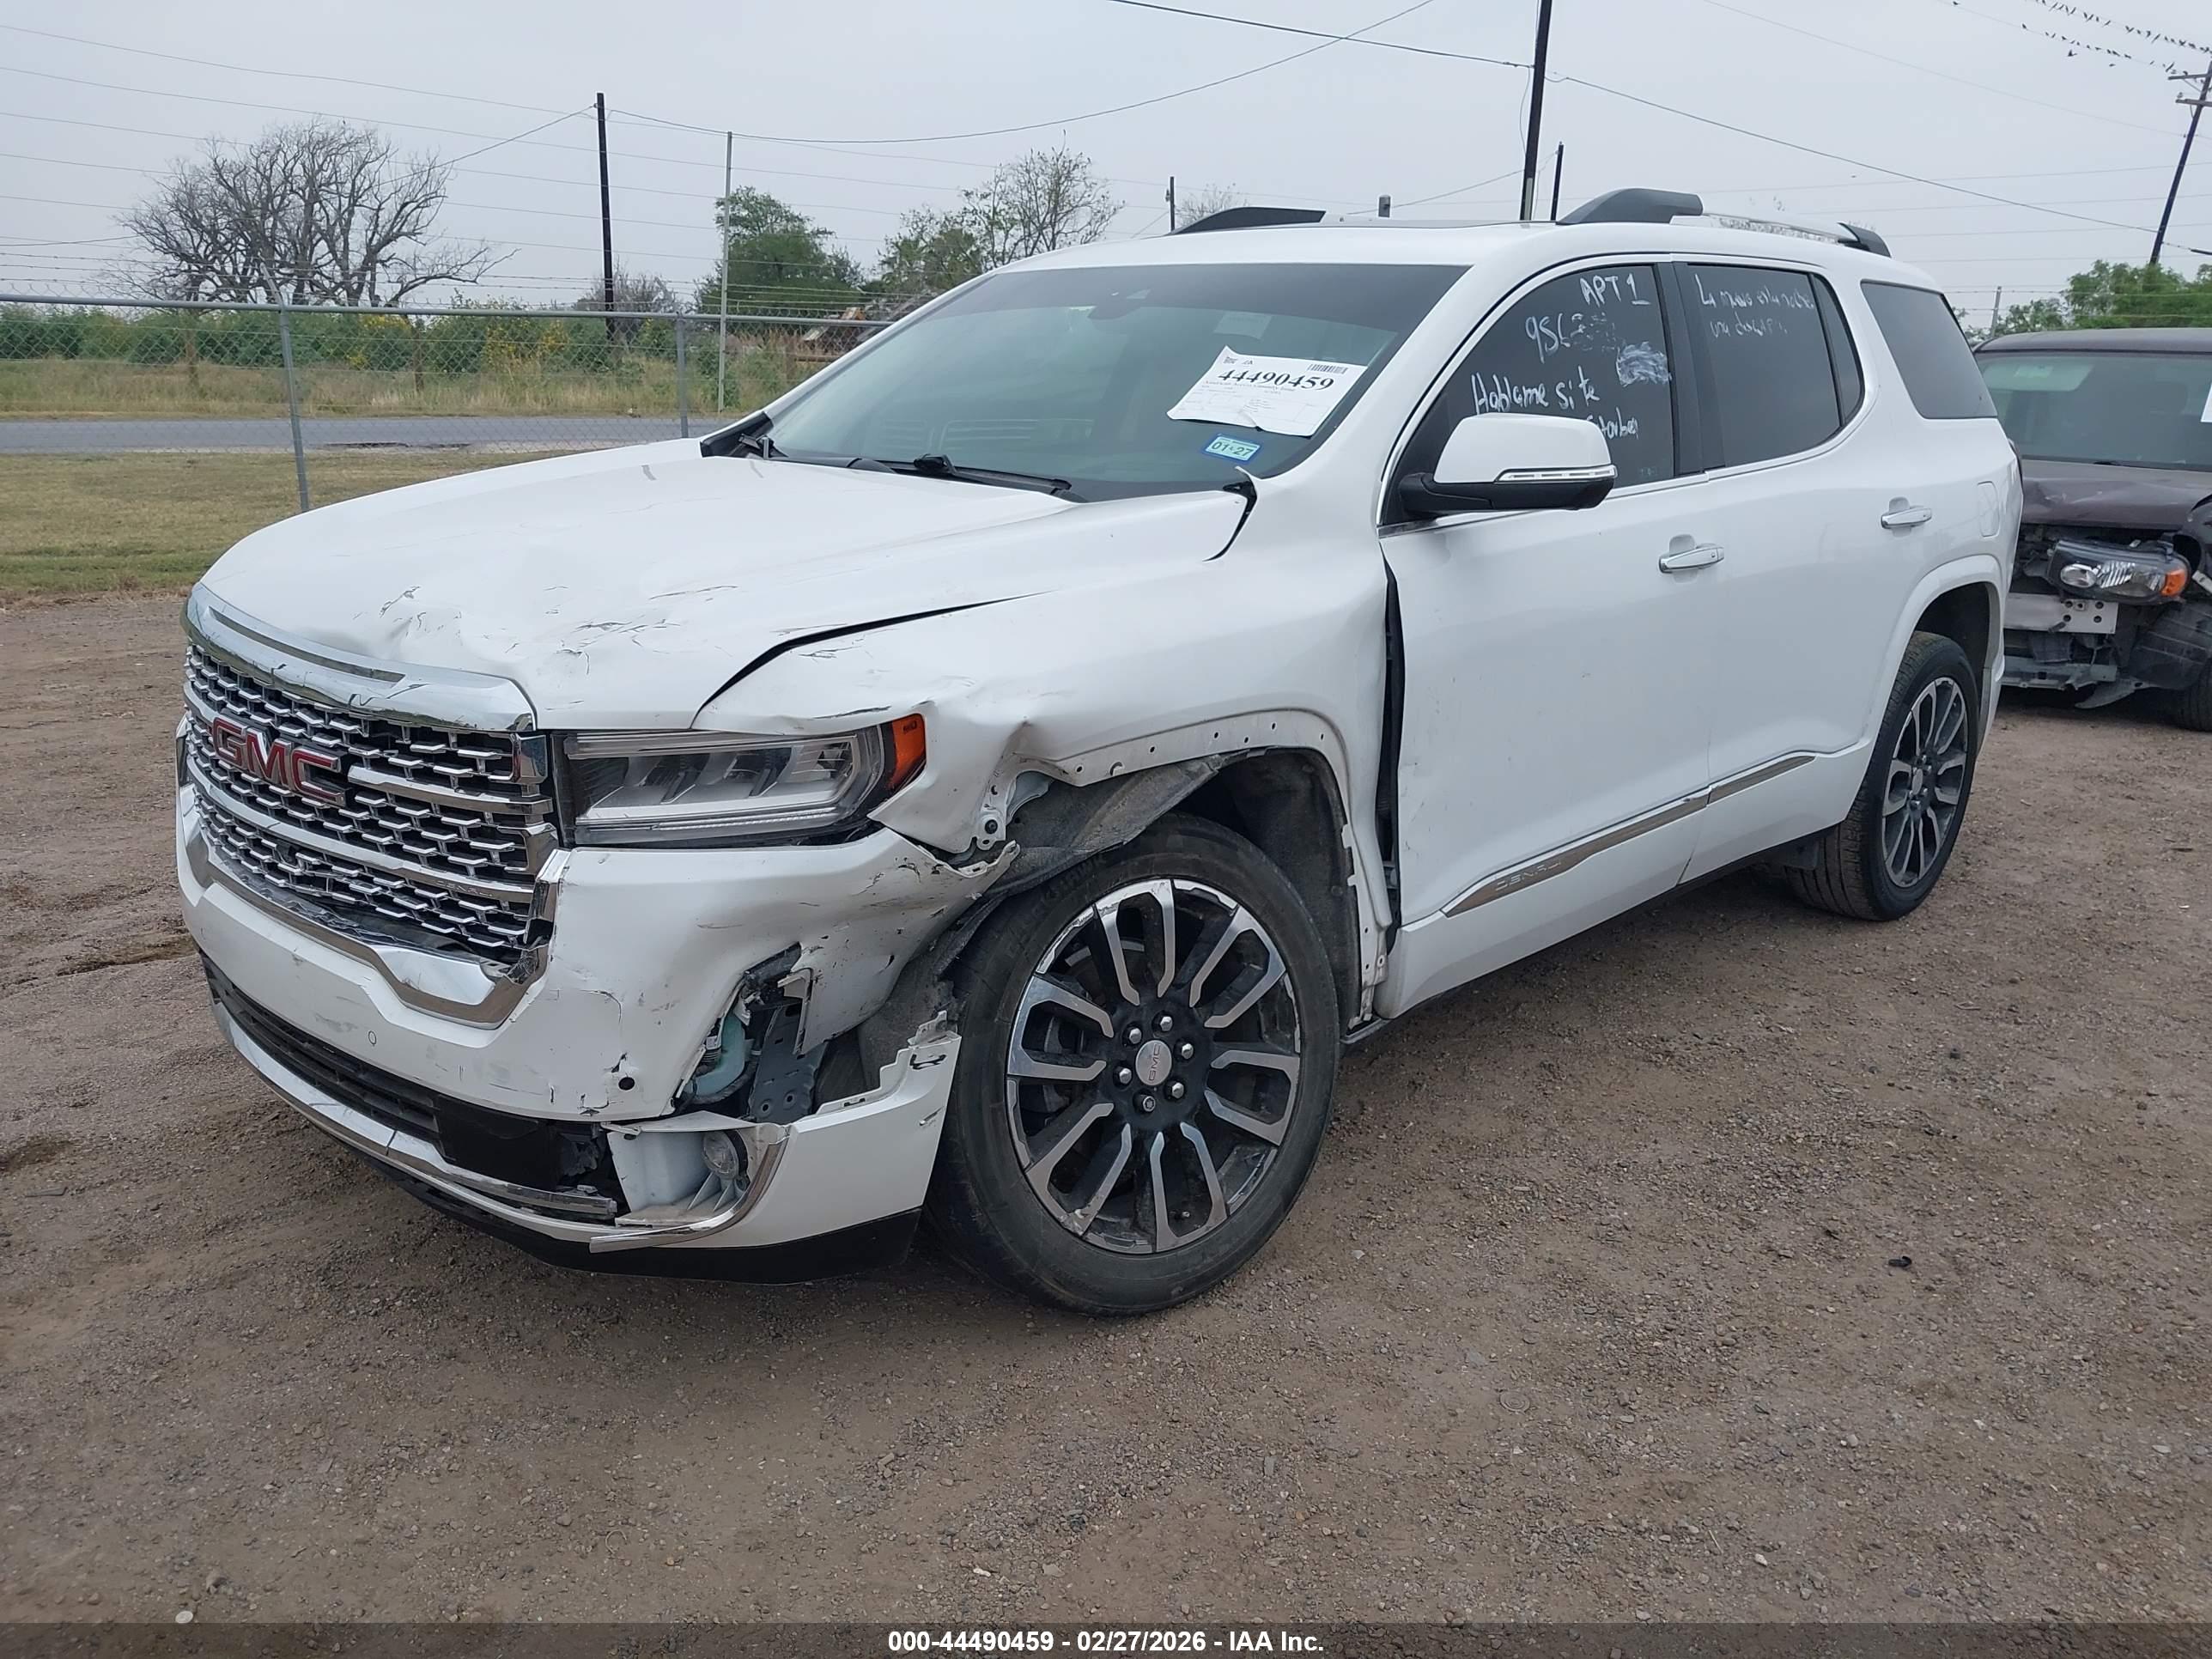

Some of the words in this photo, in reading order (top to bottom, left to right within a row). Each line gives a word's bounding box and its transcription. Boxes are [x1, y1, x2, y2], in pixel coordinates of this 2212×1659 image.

[1579, 275, 1622, 308] APT
[1218, 368, 1335, 392] 44490459
[1212, 441, 1230, 452] 01
[1233, 447, 1254, 457] 27
[212, 716, 348, 807] GMC
[1495, 862, 1561, 891] DENALI
[1148, 1044, 1161, 1081] GMC
